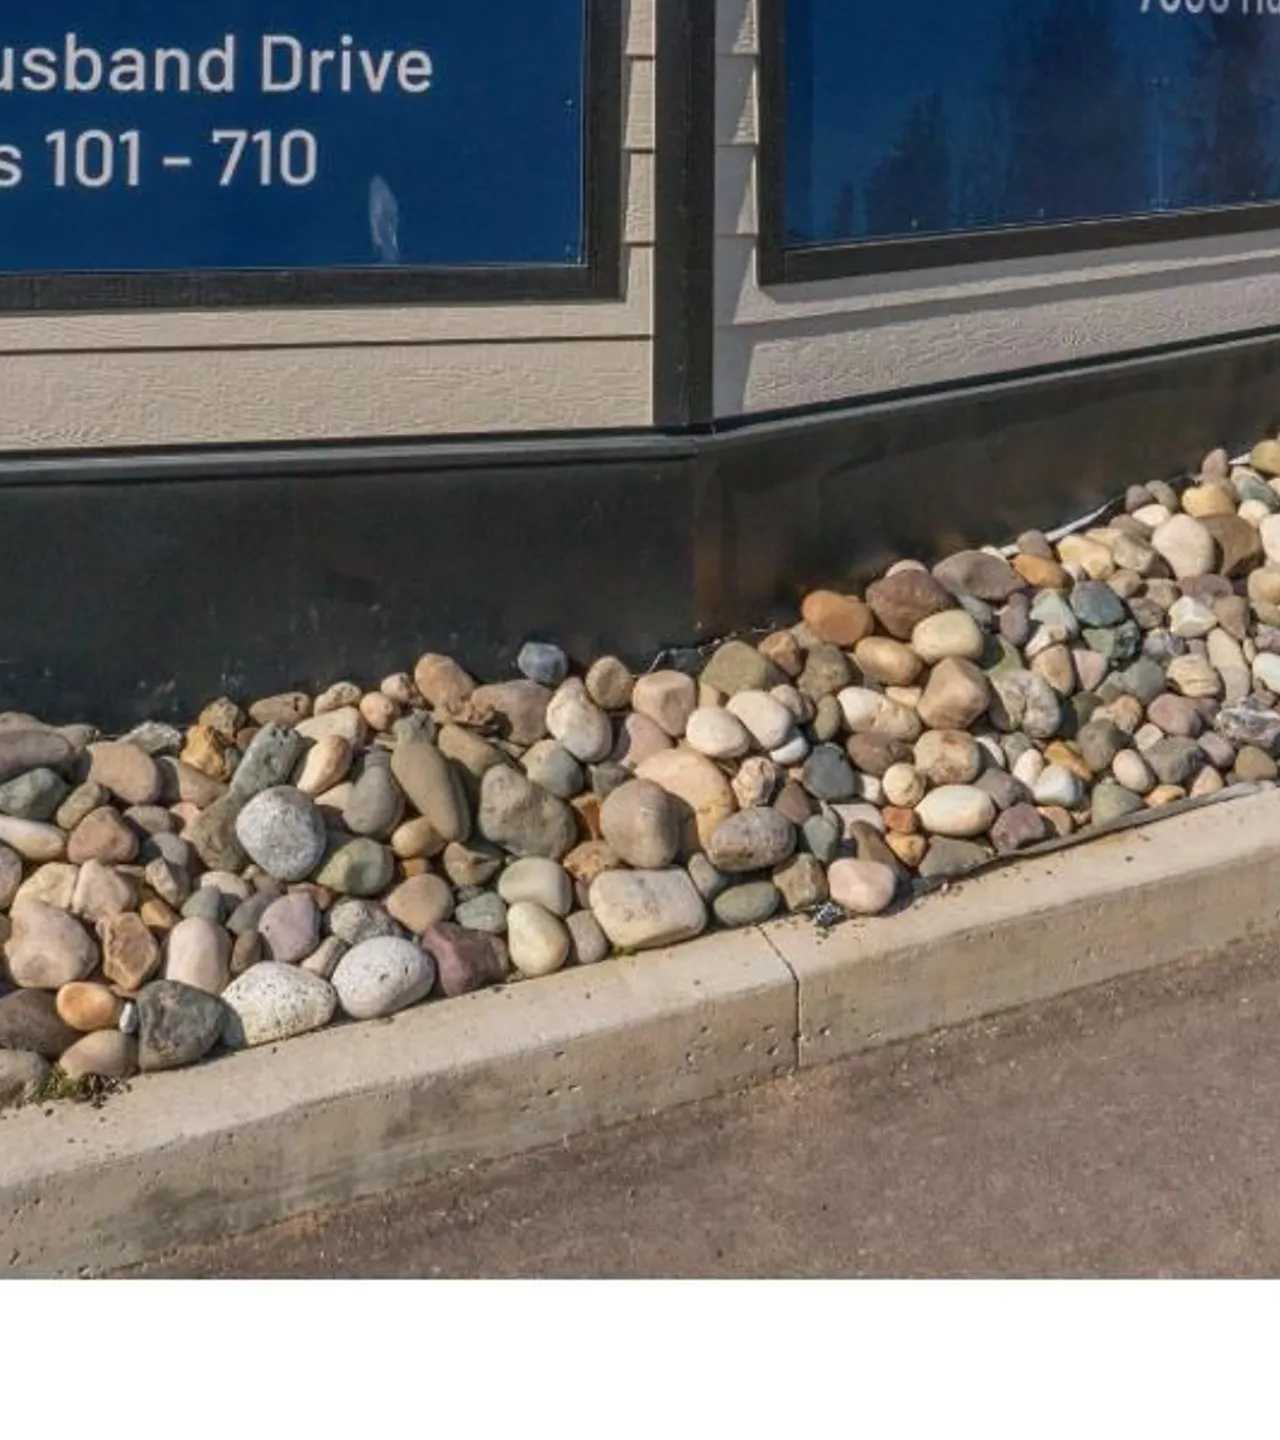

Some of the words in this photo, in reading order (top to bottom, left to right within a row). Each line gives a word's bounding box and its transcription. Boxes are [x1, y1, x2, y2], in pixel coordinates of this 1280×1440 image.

[261, 34, 433, 93] Drive
[45, 129, 141, 187] 101
[211, 129, 317, 187] 710
